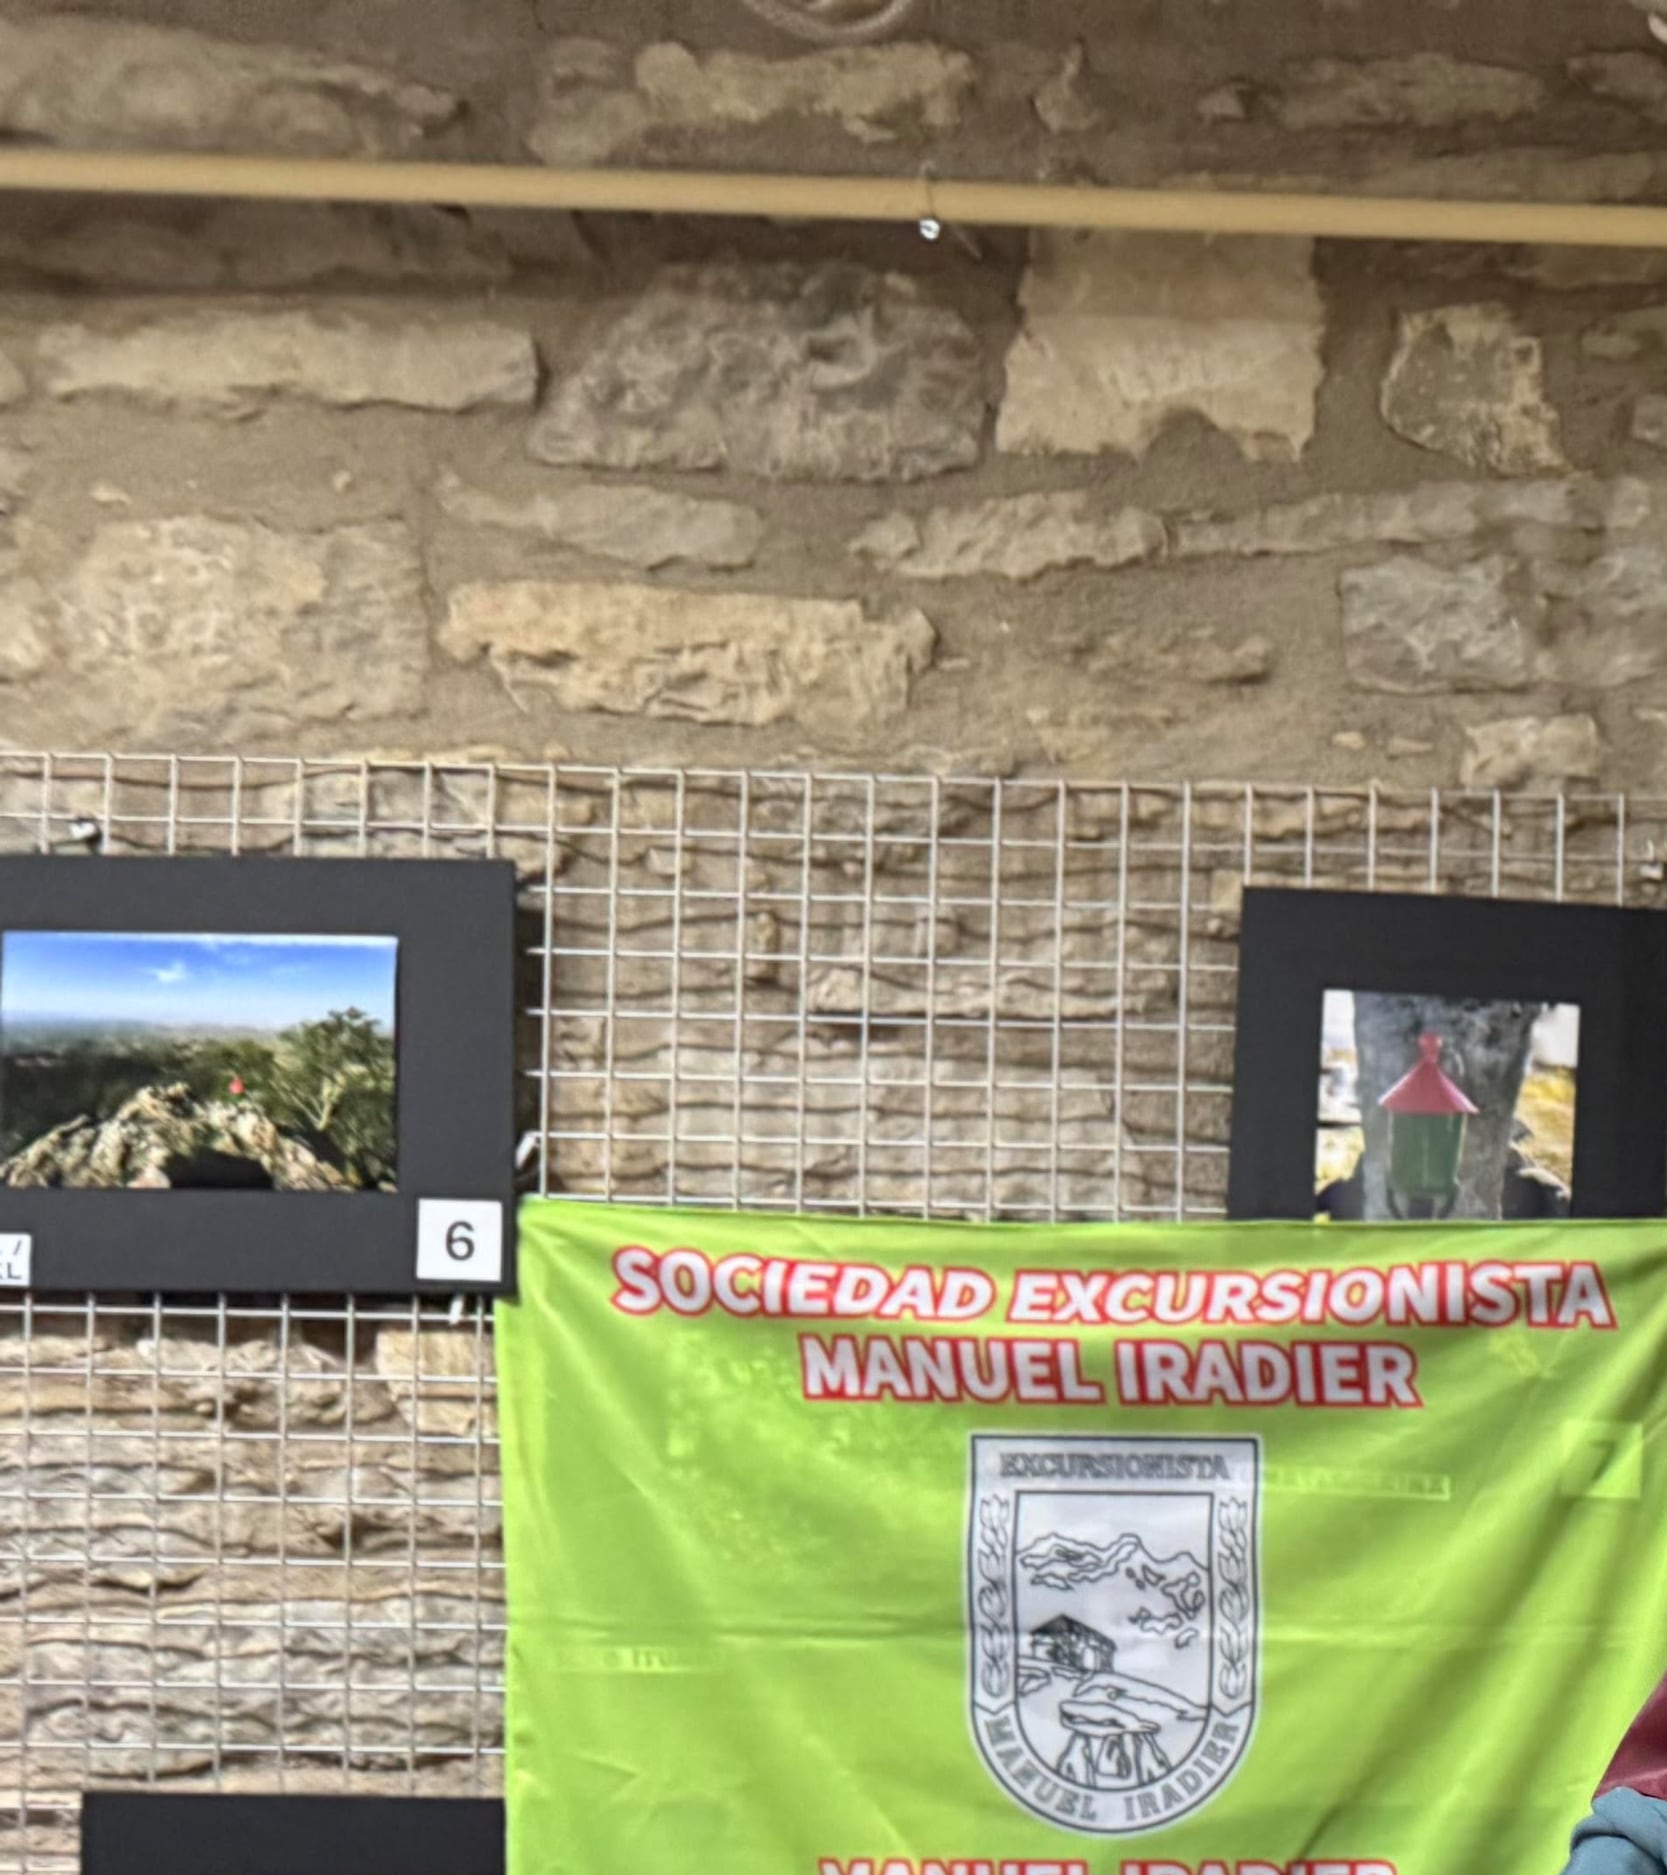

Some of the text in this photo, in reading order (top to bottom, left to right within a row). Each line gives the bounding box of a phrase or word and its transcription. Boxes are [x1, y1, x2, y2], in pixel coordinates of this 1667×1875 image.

[445, 1221, 475, 1261] 6
[610, 1246, 1617, 1329] SOCIEDAD EXCURSIONISTA
[799, 1334, 1424, 1408] MANUEL IRADIER
[1000, 1452, 1231, 1481] EXCURSIONISTA
[985, 1718, 1241, 1822] MANUEL IRADIER
